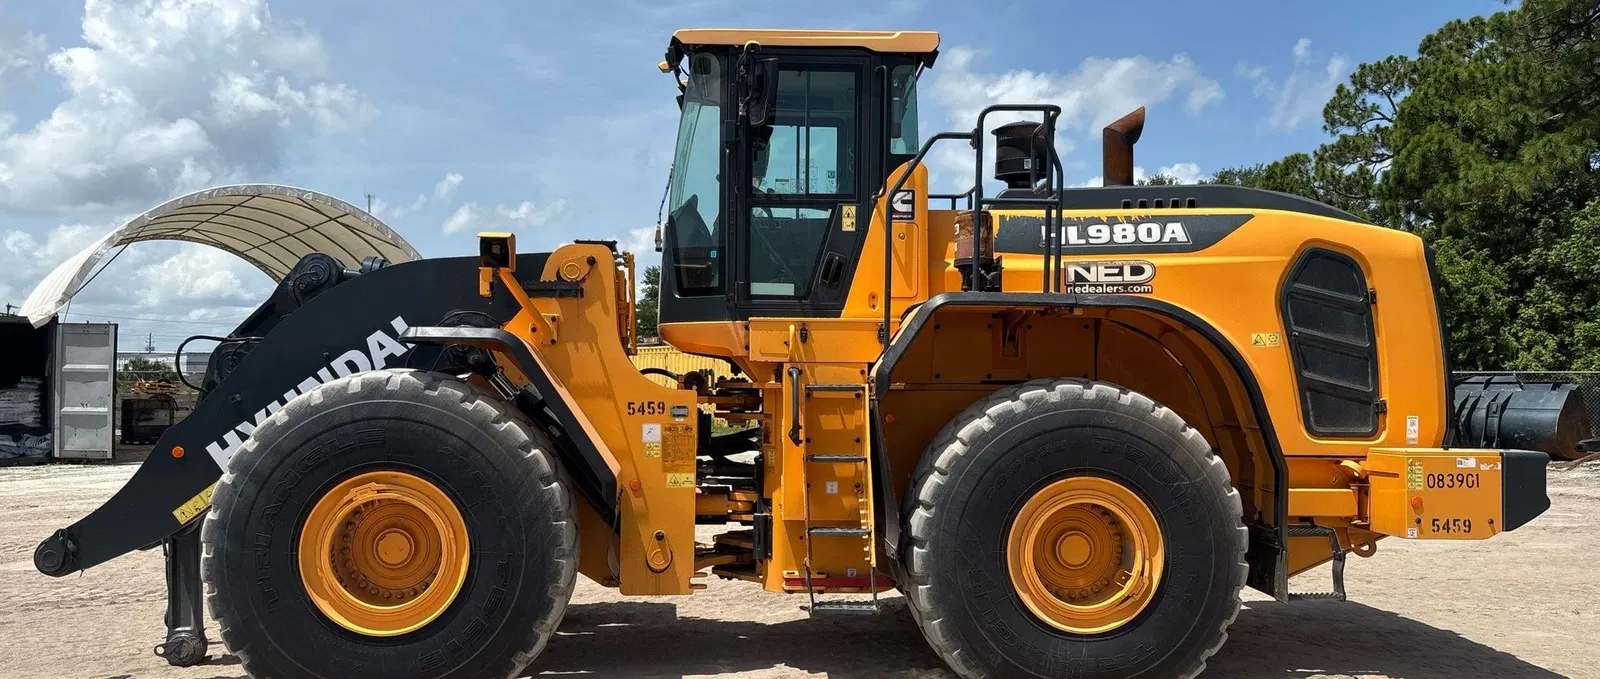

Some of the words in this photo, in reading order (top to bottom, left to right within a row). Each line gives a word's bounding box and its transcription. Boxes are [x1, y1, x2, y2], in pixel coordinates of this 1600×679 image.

[1067, 262, 1154, 283] NED
[1067, 284, 1152, 295] nedealers.com
[627, 401, 665, 415] 5459
[1431, 518, 1471, 533] 5459
